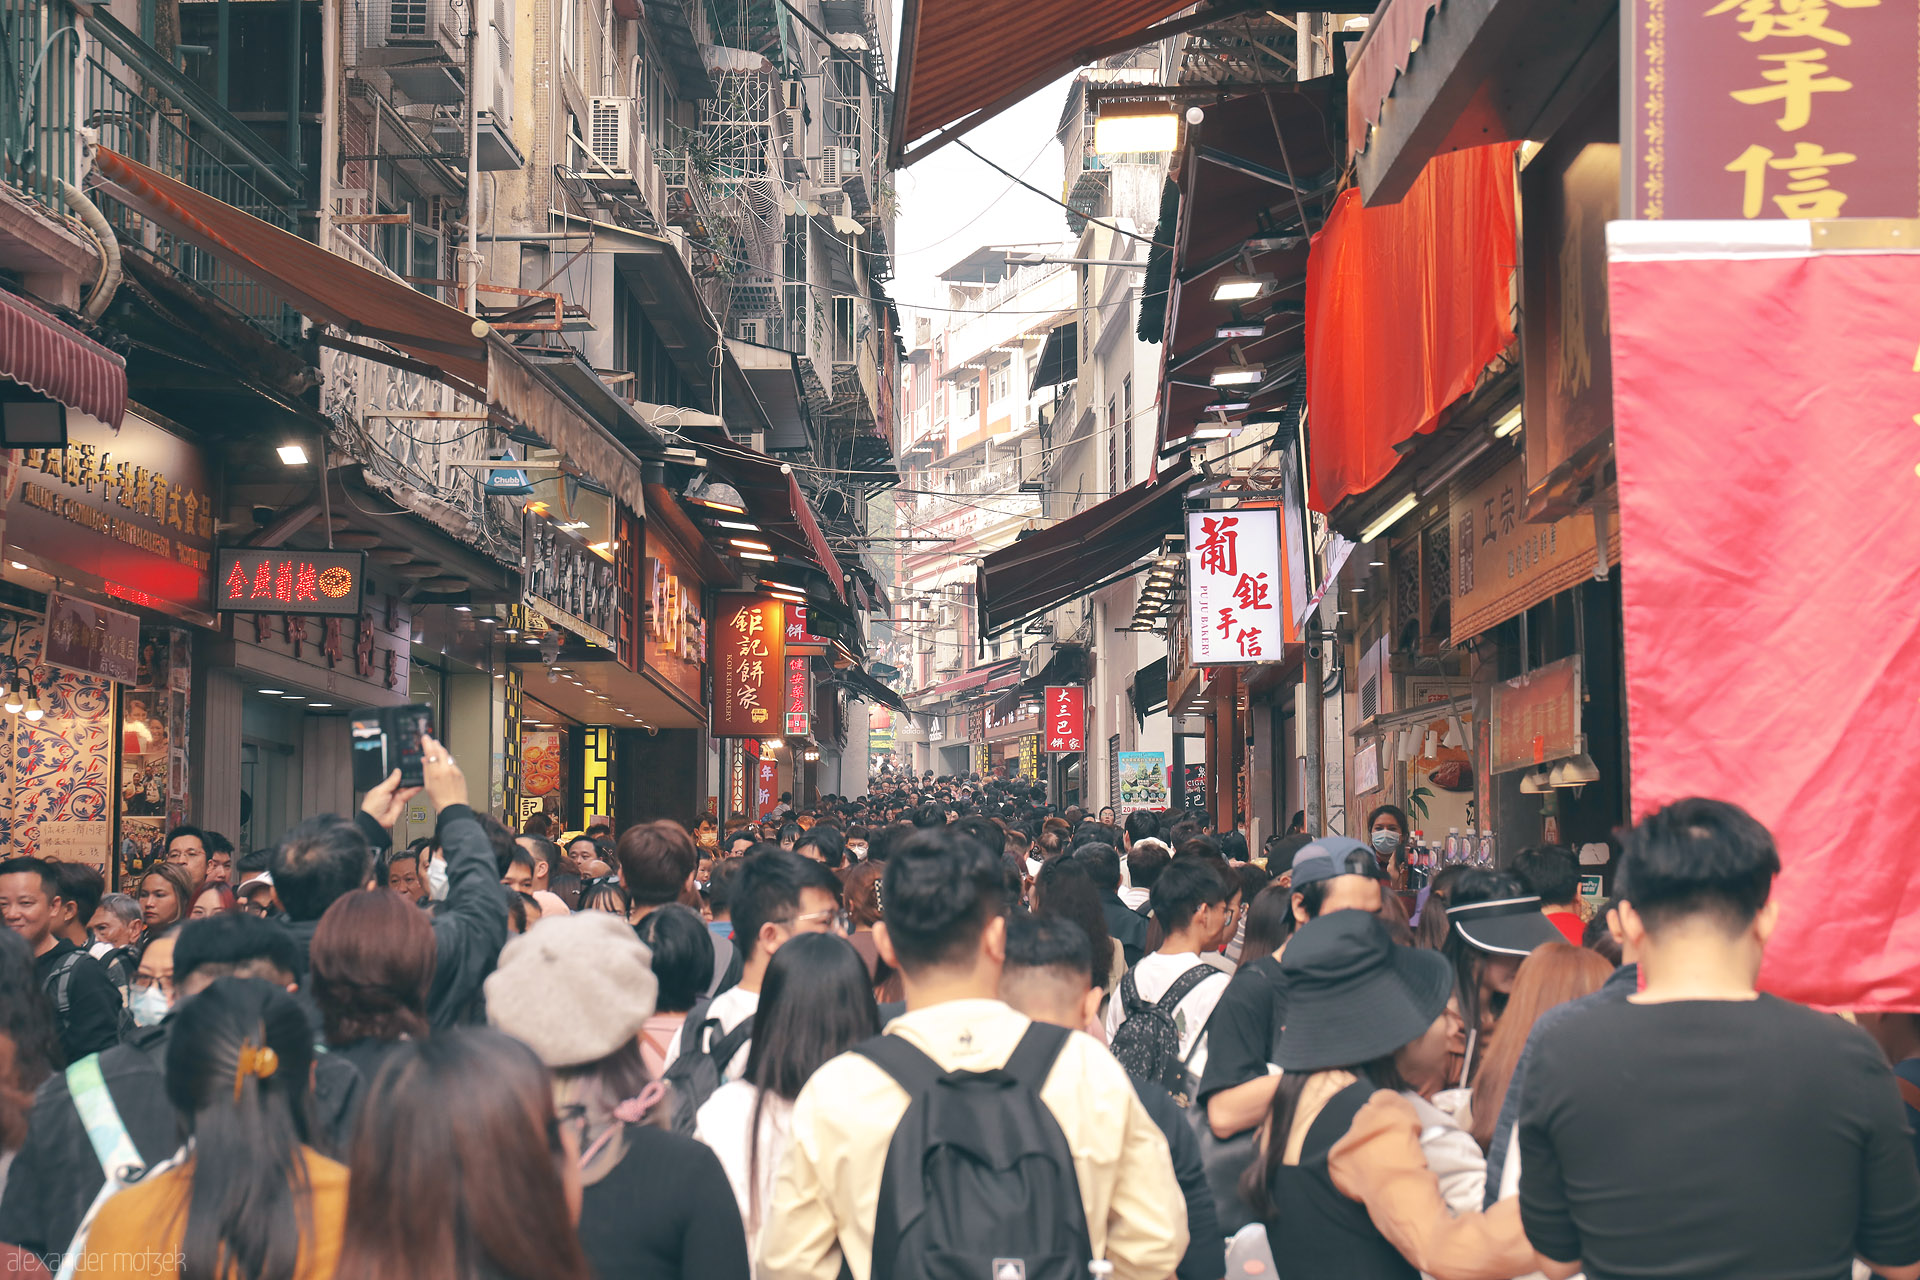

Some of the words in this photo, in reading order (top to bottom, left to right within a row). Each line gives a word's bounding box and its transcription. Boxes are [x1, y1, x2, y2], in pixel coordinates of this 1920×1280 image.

[494, 476, 520, 484] Chubb
[111, 517, 170, 558] PORTUGUESA
[1200, 585, 1208, 598] PU
[1200, 600, 1208, 613] JU
[1201, 616, 1210, 657] BAKERY
[730, 606, 768, 709] 鉅記餅家
[1056, 689, 1072, 735] 大三巴
